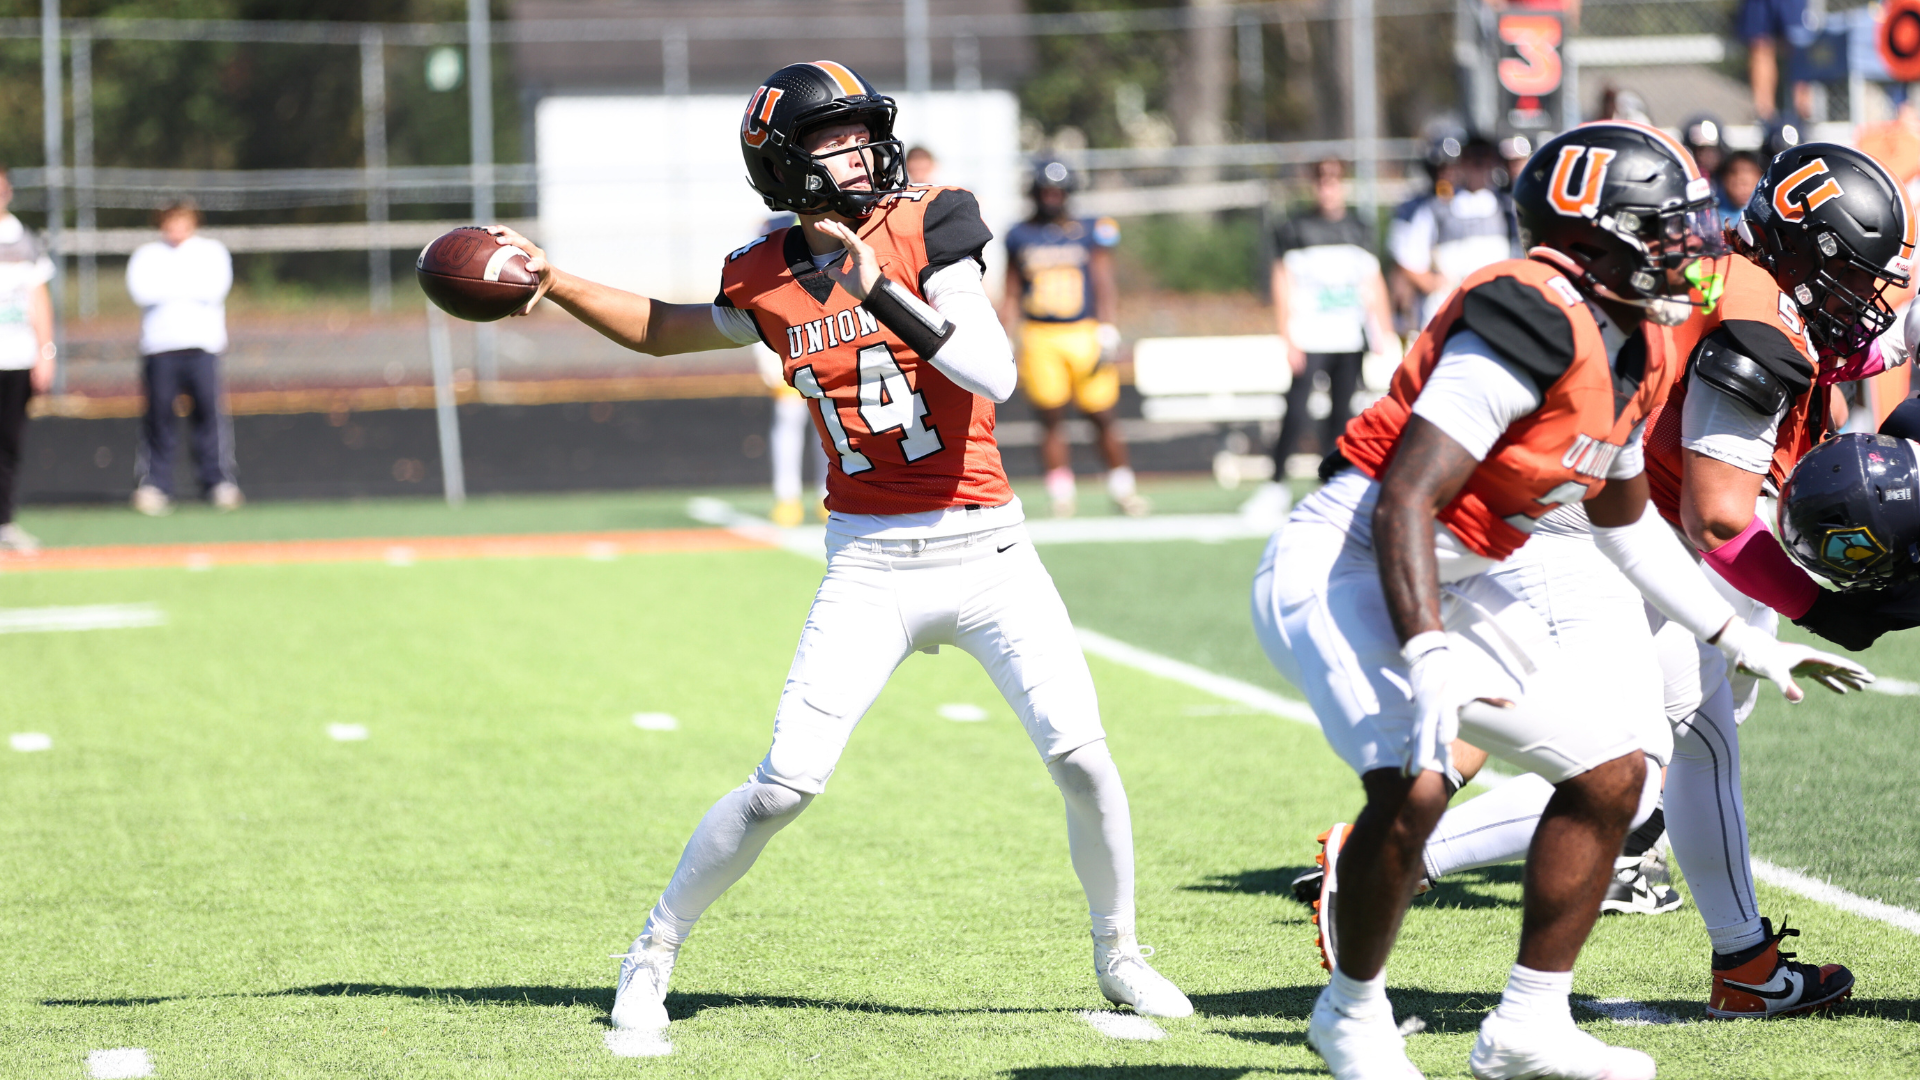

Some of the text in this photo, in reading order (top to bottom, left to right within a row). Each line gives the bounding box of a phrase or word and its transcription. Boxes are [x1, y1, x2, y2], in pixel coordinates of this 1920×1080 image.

[1498, 15, 1562, 96] 3
[742, 85, 785, 149] U
[1547, 145, 1617, 218] U
[1772, 157, 1845, 223] U
[787, 306, 879, 359] UNION
[792, 341, 946, 476] 14
